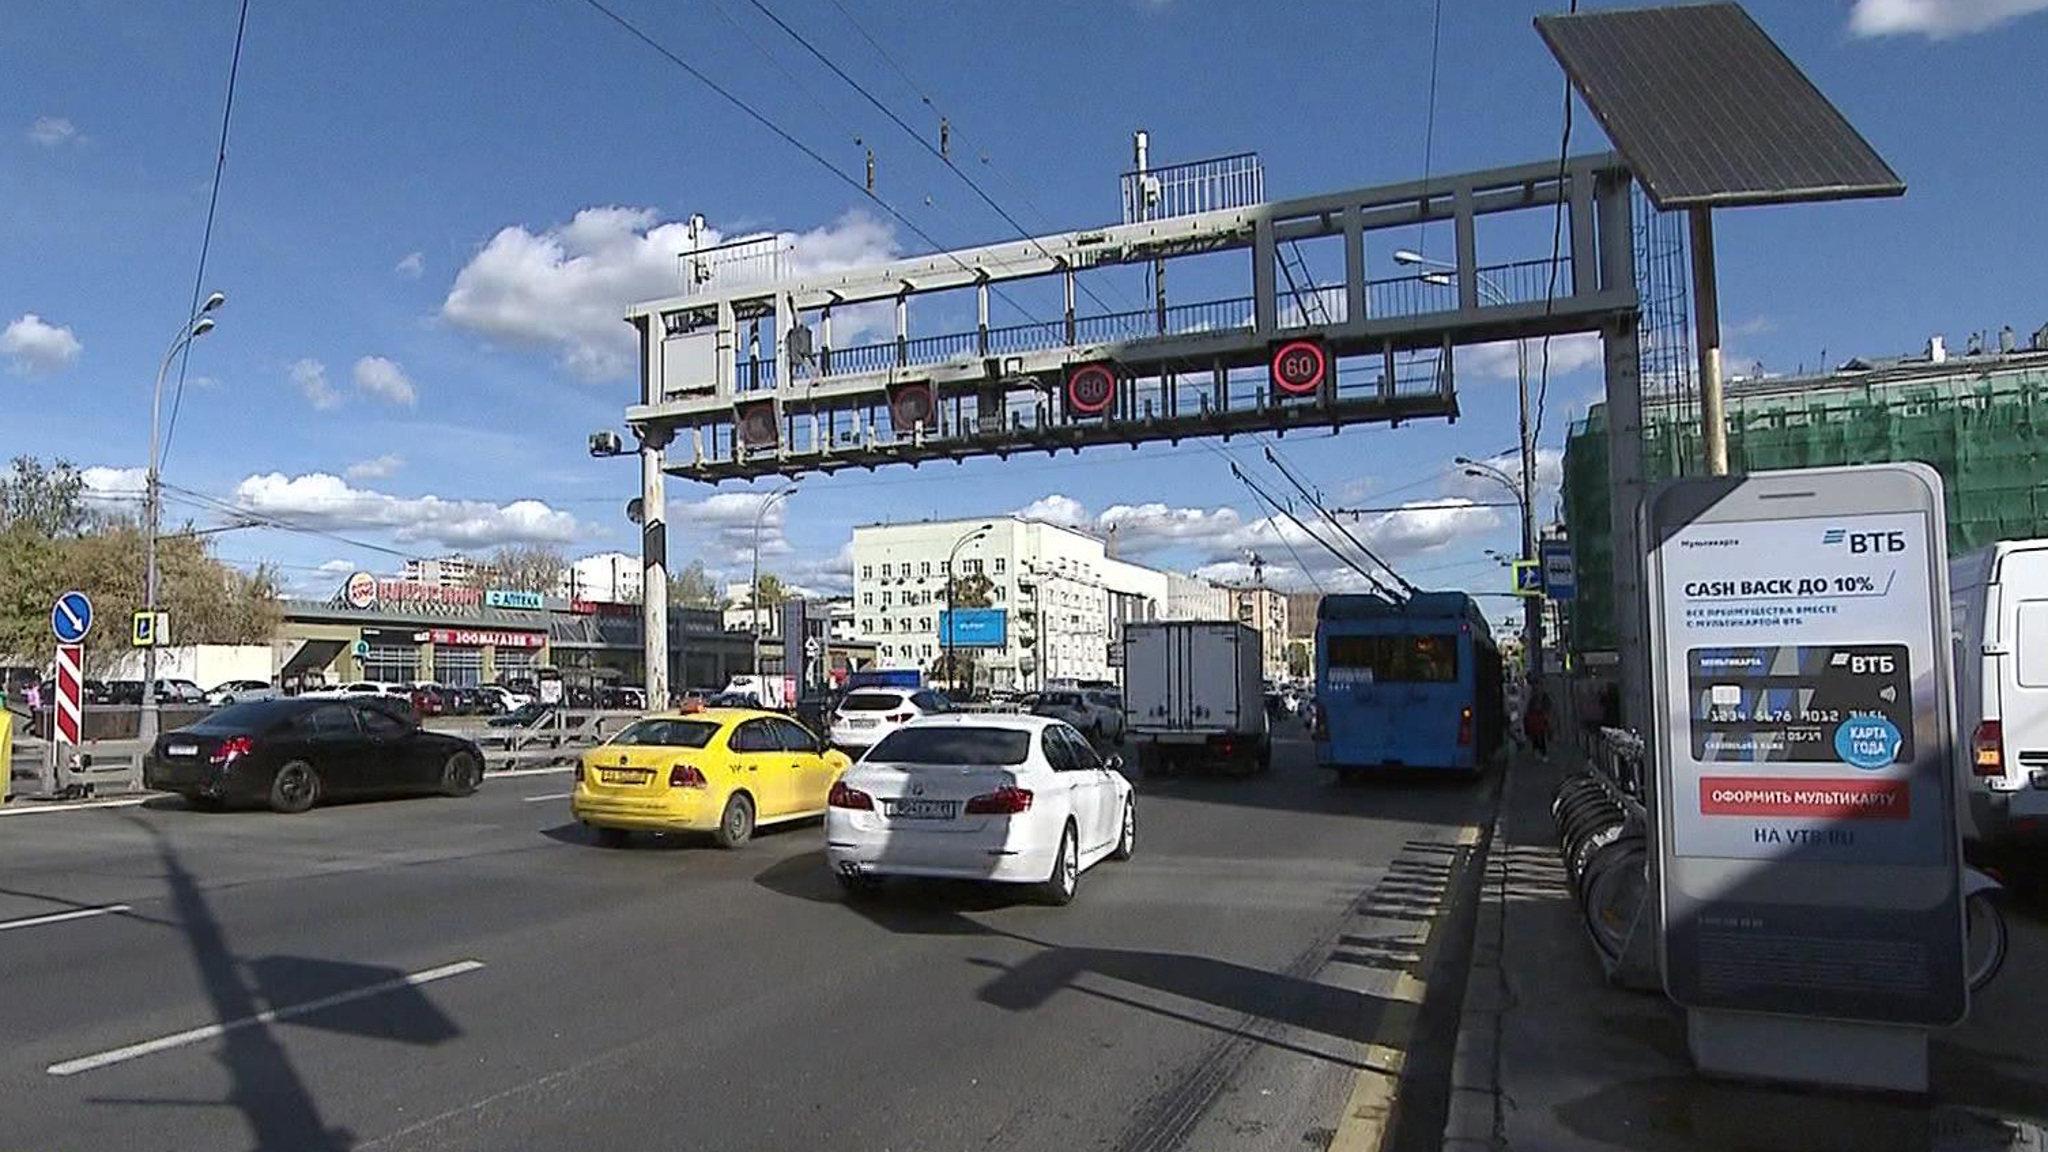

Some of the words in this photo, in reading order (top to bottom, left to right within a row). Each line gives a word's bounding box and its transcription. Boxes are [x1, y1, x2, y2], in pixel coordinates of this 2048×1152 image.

[1286, 358, 1311, 377] 60
[1079, 381, 1102, 399] 60
[1850, 531, 1905, 554] ВТБ
[1685, 581, 1735, 597] CASH
[1741, 579, 1793, 595] BACK
[1798, 579, 1828, 596] ДО
[1834, 576, 1874, 592] 10%
[1852, 655, 1895, 673] ВТБ
[1850, 726, 1887, 740] КАРТА
[1853, 741, 1887, 755] ГОДА
[1712, 789, 1792, 804] ОФОРМИТЬ
[1794, 791, 1896, 807] МУЛЬТИКАРТУ
[1754, 828, 1781, 843] НА
